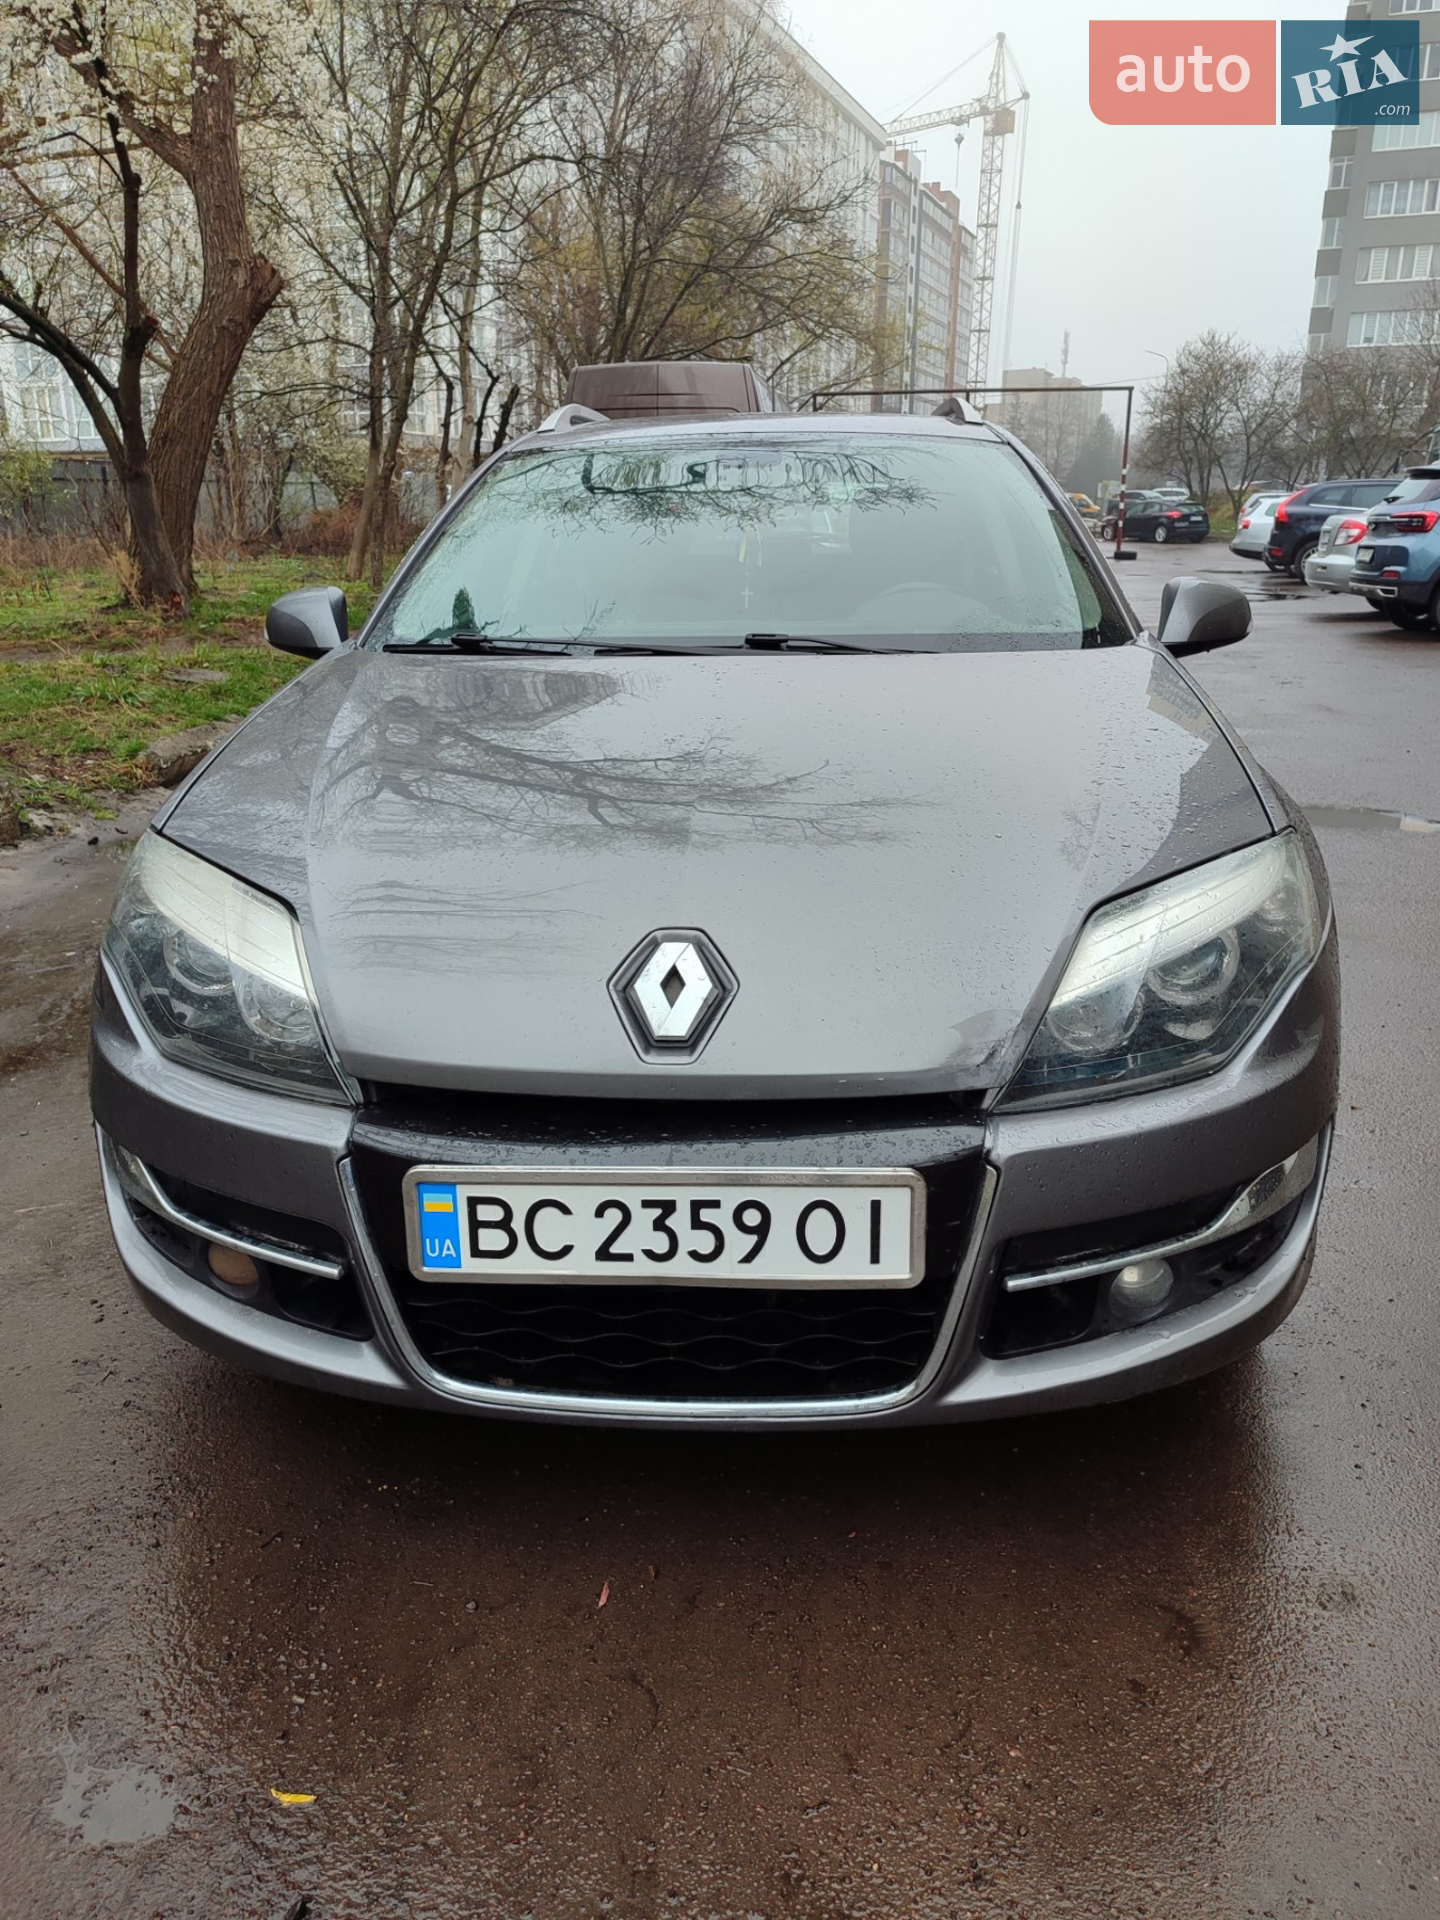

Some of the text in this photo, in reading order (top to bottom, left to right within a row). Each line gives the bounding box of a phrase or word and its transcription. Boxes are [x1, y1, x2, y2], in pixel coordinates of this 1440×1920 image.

[425, 1238, 456, 1259] UA
[466, 1195, 882, 1264] BC 2359 OI
